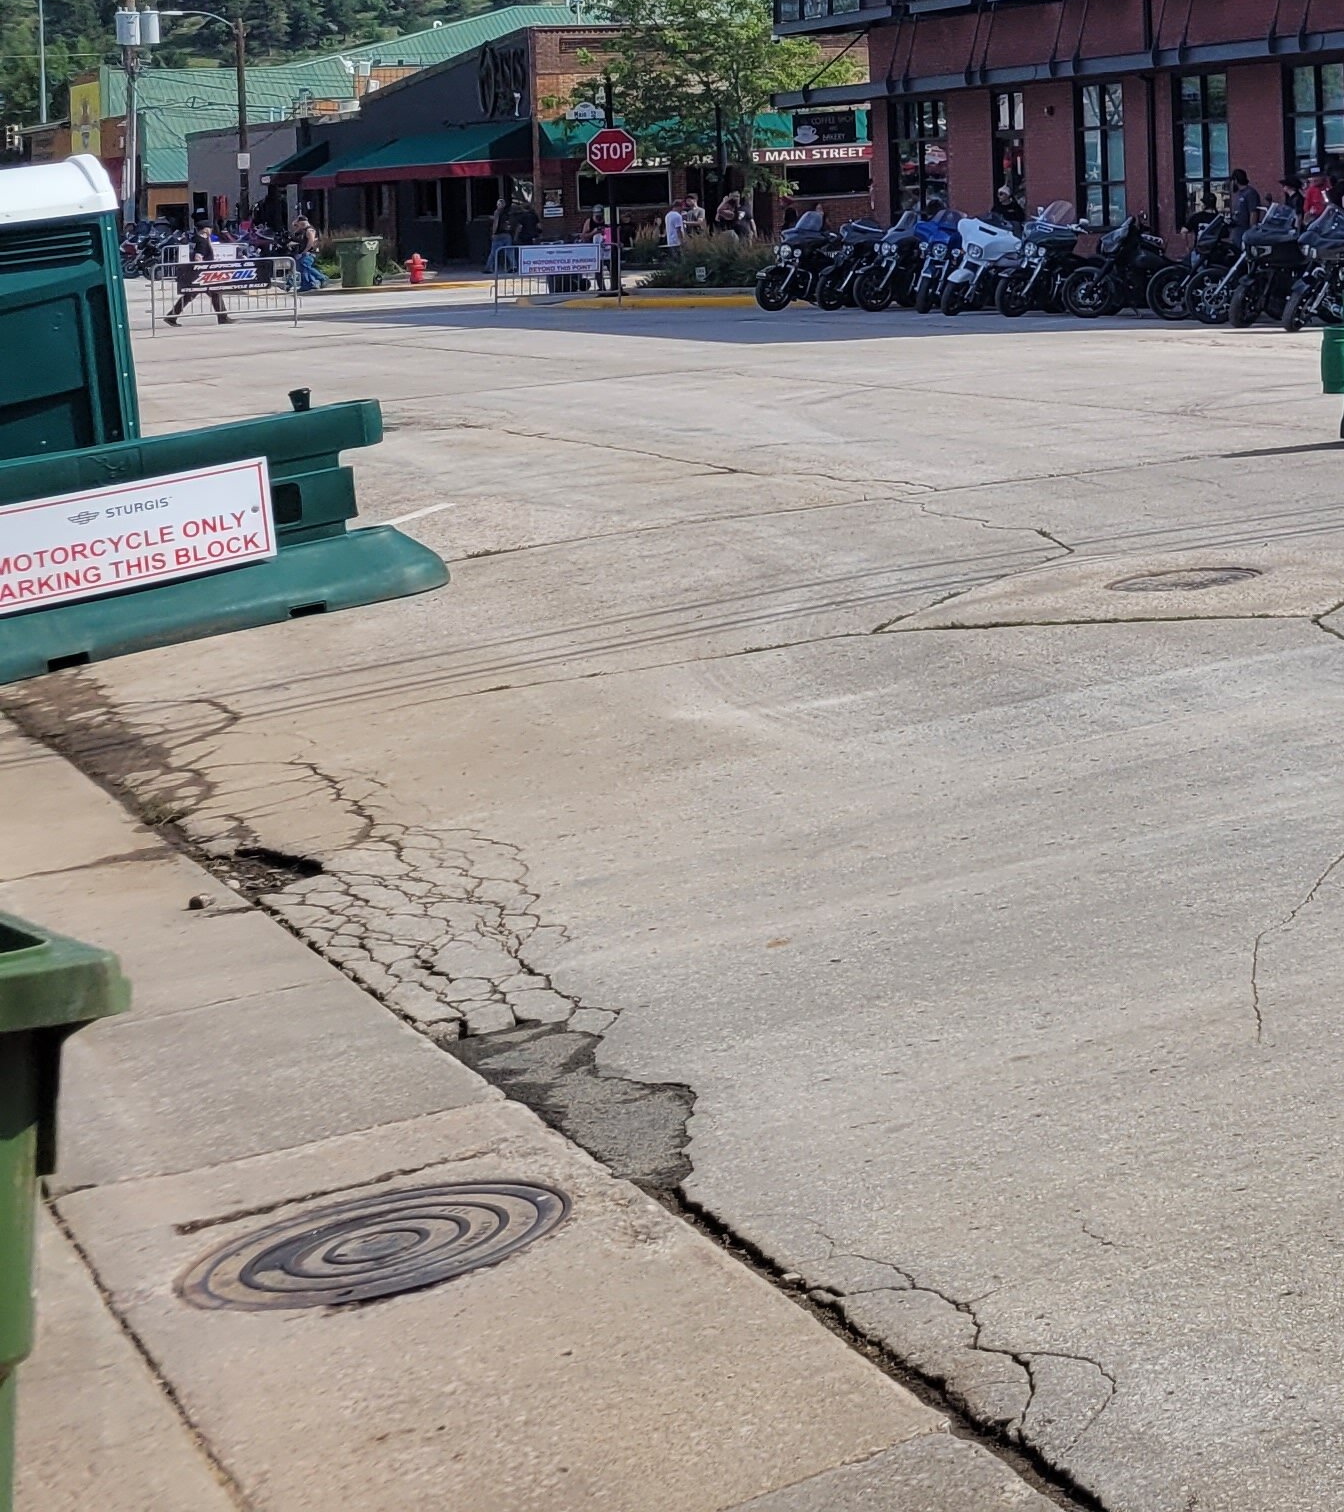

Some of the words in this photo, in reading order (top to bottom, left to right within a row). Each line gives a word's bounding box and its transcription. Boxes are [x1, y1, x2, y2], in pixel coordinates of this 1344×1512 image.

[591, 142, 632, 160] STOP
[765, 150, 806, 162] MAIN
[812, 147, 865, 159] STREET
[199, 269, 255, 285] AMSOIL
[105, 497, 169, 518] STURGIS
[0, 525, 175, 575] MOTORCYCLE
[182, 510, 246, 538] ONLY
[109, 552, 167, 579] THIS
[175, 532, 261, 566] BLOCK
